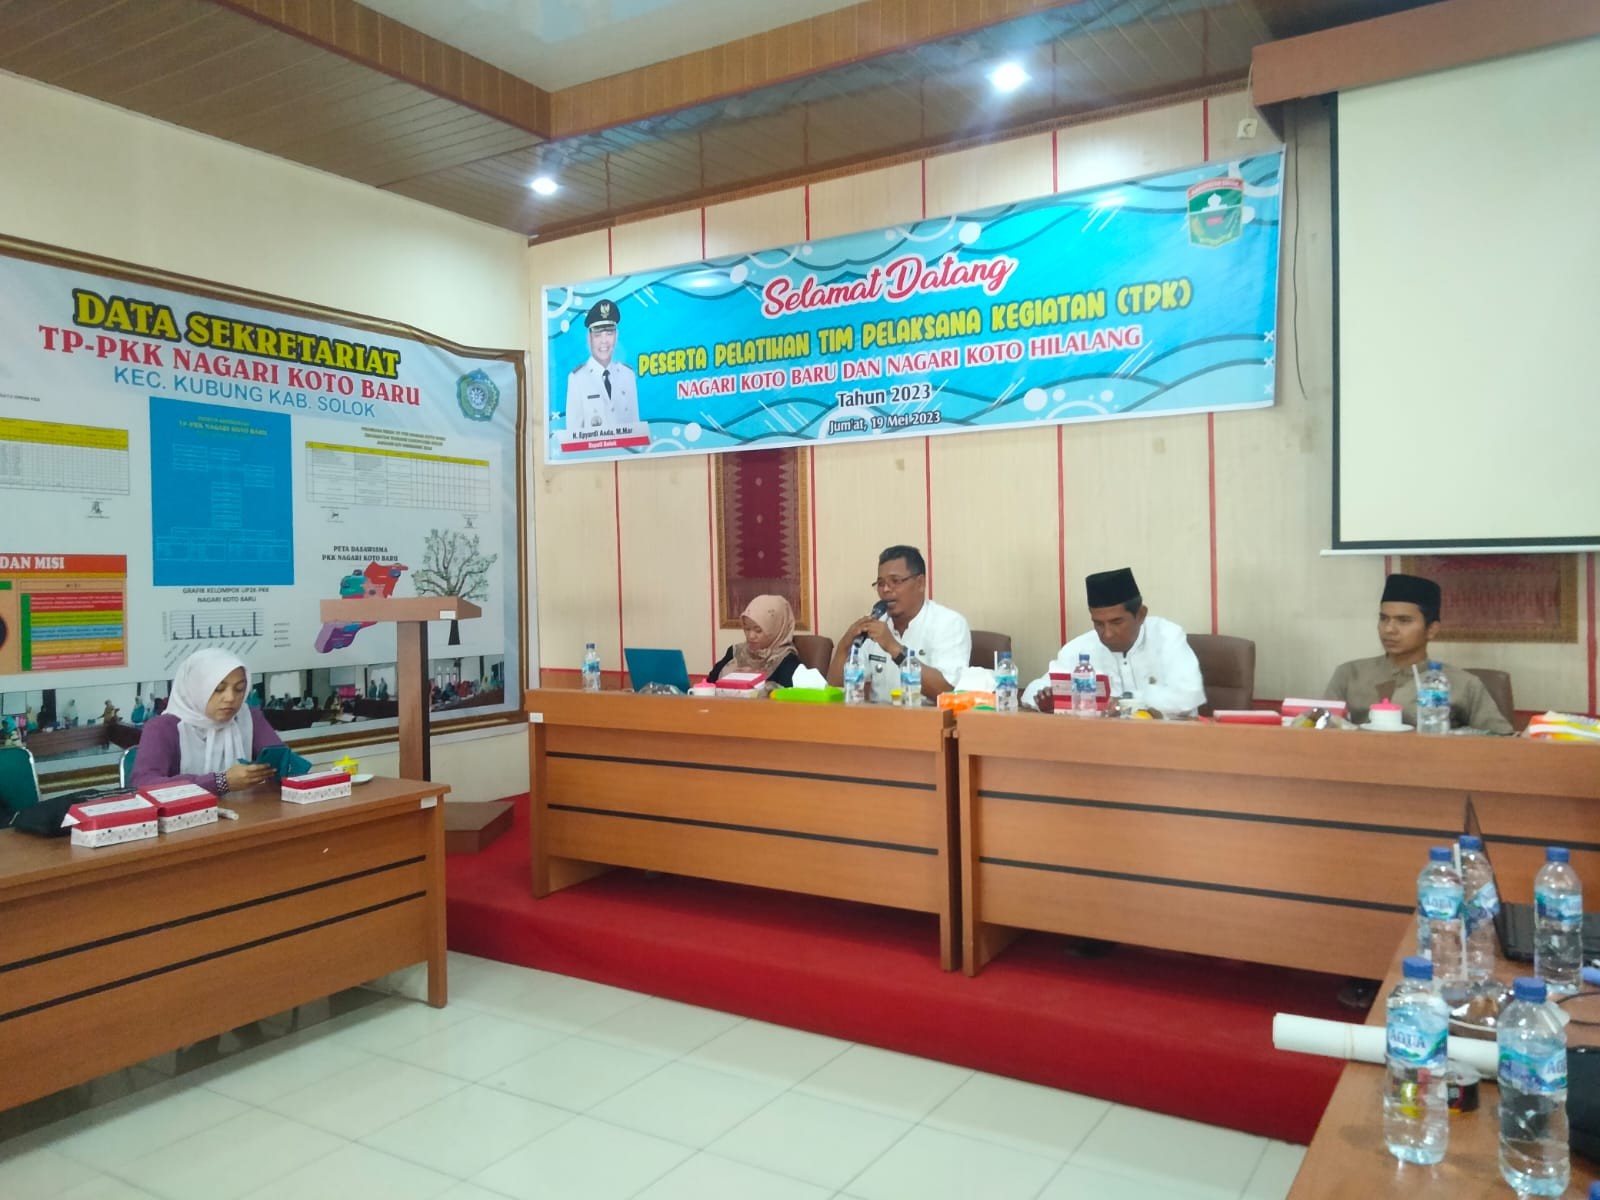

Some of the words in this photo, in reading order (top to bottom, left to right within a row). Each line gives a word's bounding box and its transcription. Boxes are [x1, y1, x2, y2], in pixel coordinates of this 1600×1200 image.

[764, 266, 881, 317] Selamat
[886, 254, 1015, 300] Datang
[72, 288, 182, 343] DATA
[185, 313, 401, 380] SEKRETARIAT
[637, 346, 708, 377] PESERTA
[714, 332, 811, 369] PELATIHAN
[817, 325, 853, 354] TIM
[861, 306, 982, 347] PELAKSANA
[990, 288, 1107, 333] KEGIATAN
[1116, 277, 1192, 315] (TPK)
[39, 324, 165, 368] TP-PKK
[173, 348, 280, 386] NAGARI
[287, 367, 355, 396] KOTO
[361, 379, 421, 406] BARU
[677, 376, 736, 399] NAGARI
[741, 371, 786, 391] KOTO
[791, 365, 837, 386] BARU
[842, 359, 882, 380] DAN
[887, 347, 960, 374] NAGARI
[966, 340, 1023, 365] KOTO
[1030, 326, 1142, 359] HILALANG
[114, 366, 168, 391] KEC.
[174, 375, 264, 404] KUBUNG
[269, 388, 313, 411] KAB.
[318, 396, 377, 419] SOLOK
[837, 390, 885, 408] Tahun
[891, 384, 931, 402] 2023
[871, 416, 884, 428] 19
[911, 411, 942, 425] 2023
[0, 556, 31, 570] DAN
[35, 557, 65, 570] MISI
[333, 545, 349, 553] PETA
